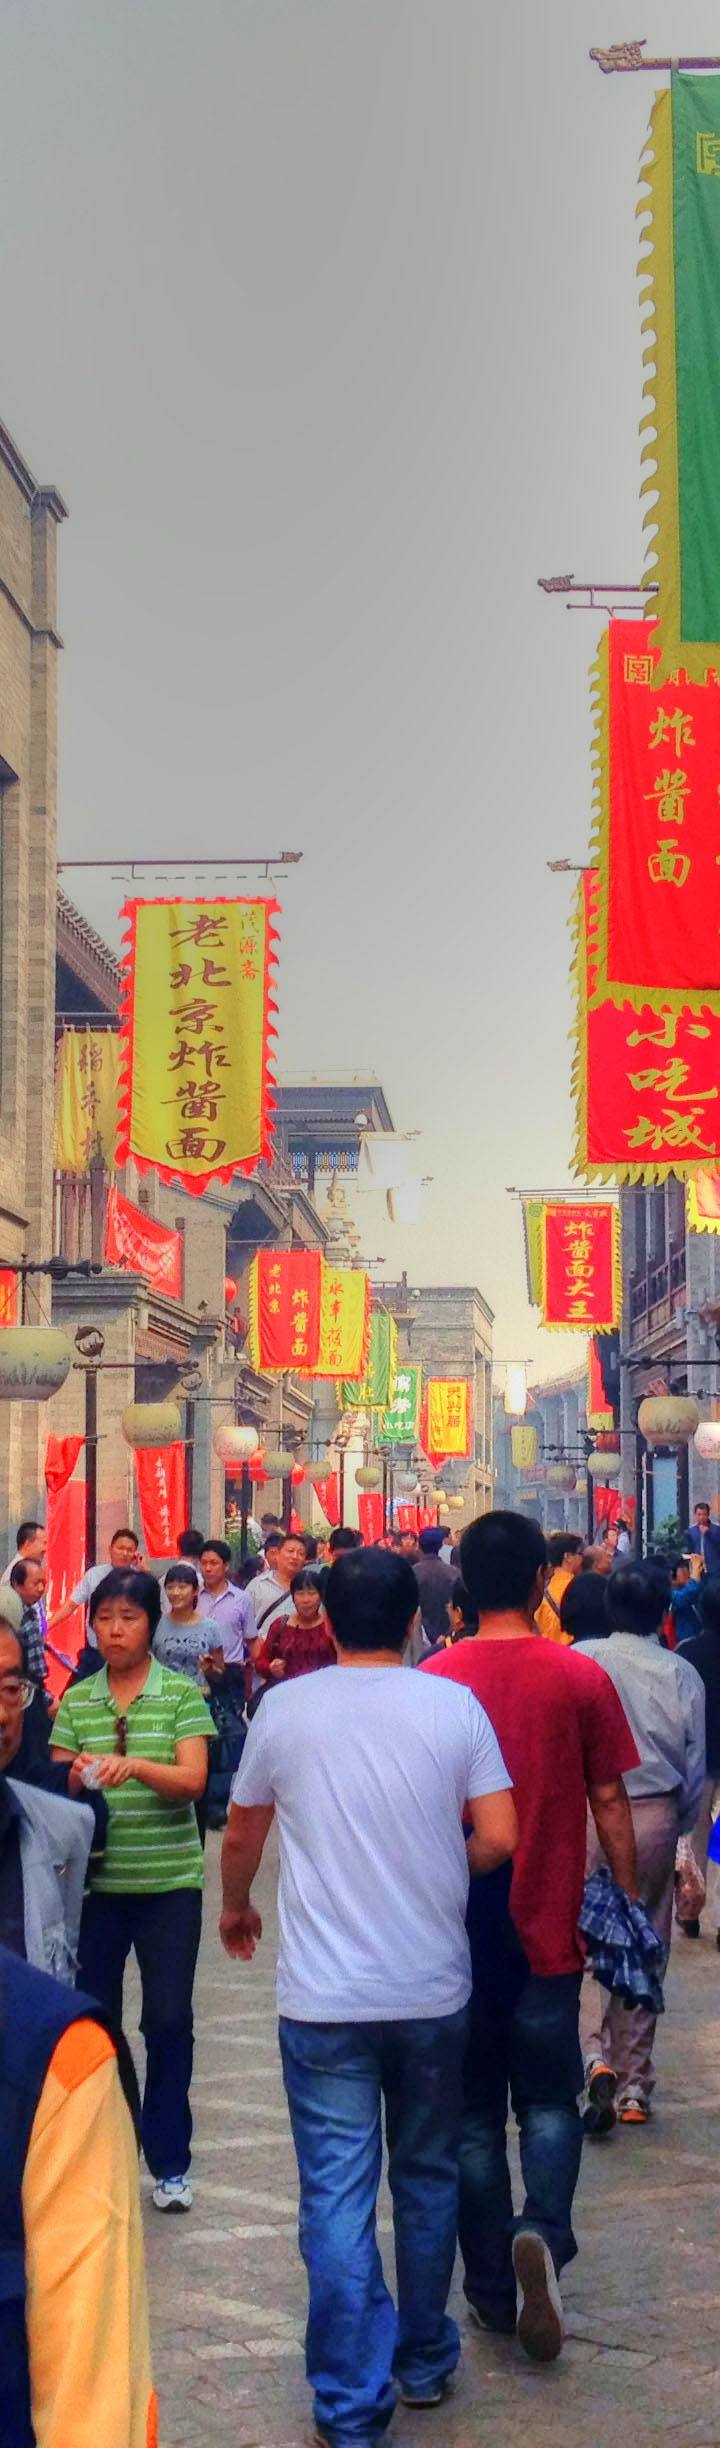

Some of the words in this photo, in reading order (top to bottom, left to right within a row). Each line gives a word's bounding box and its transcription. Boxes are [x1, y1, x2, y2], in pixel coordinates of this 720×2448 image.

[643, 706, 697, 888] 炸酱面
[161, 914, 232, 1162] 老北京炸酱面
[621, 1012, 719, 1155] 小吃城
[268, 1264, 281, 1313] 老北京
[289, 1288, 310, 1357] 炸酱面
[561, 1216, 595, 1319] 炸酱面大王
